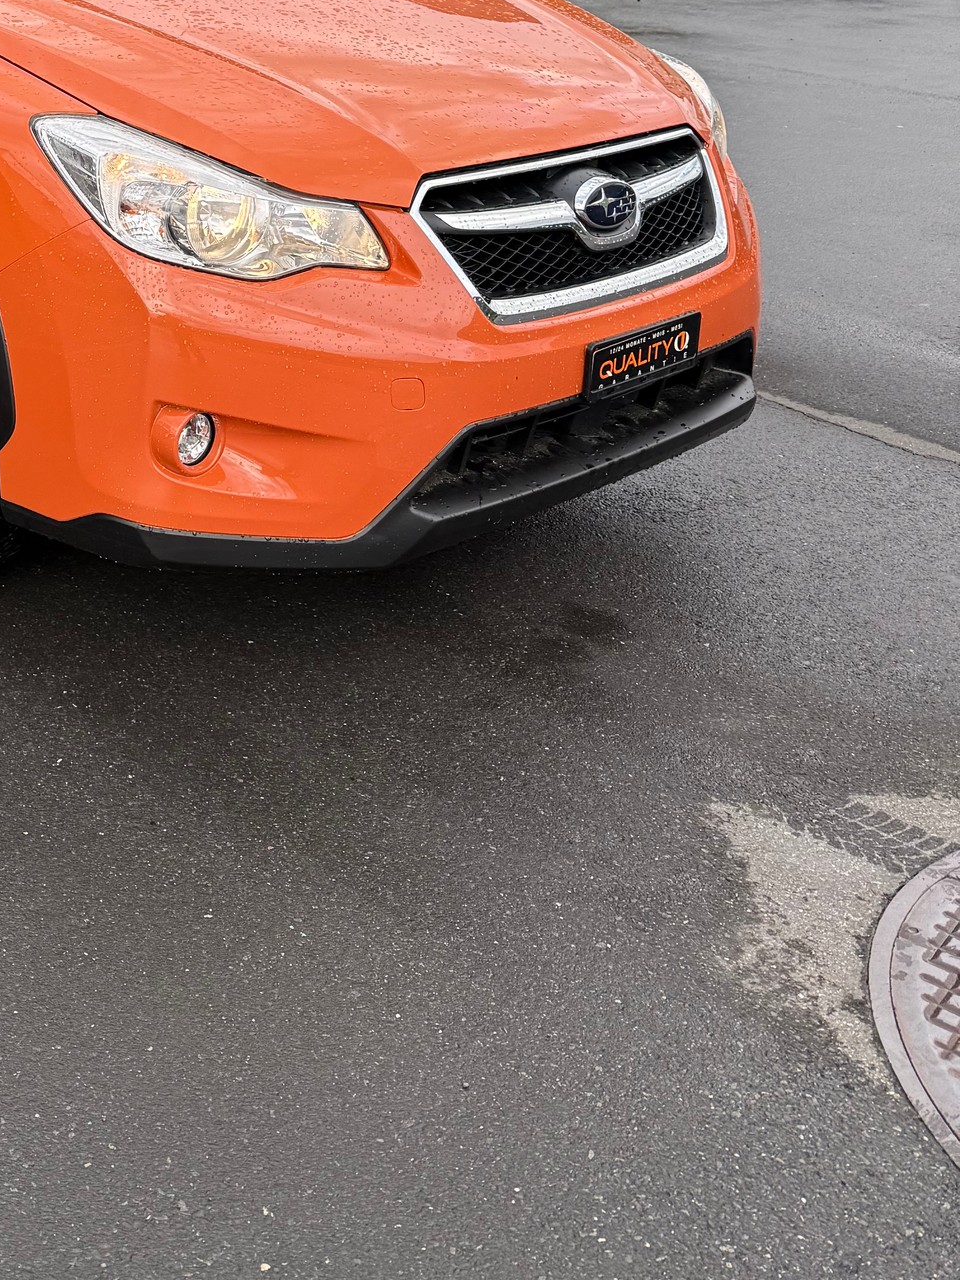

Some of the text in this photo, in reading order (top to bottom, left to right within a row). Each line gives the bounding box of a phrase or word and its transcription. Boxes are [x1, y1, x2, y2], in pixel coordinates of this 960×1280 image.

[625, 336, 647, 349] MONATE
[652, 330, 665, 339] MOIS
[670, 323, 684, 332] MESI
[599, 336, 674, 380] QUALITY
